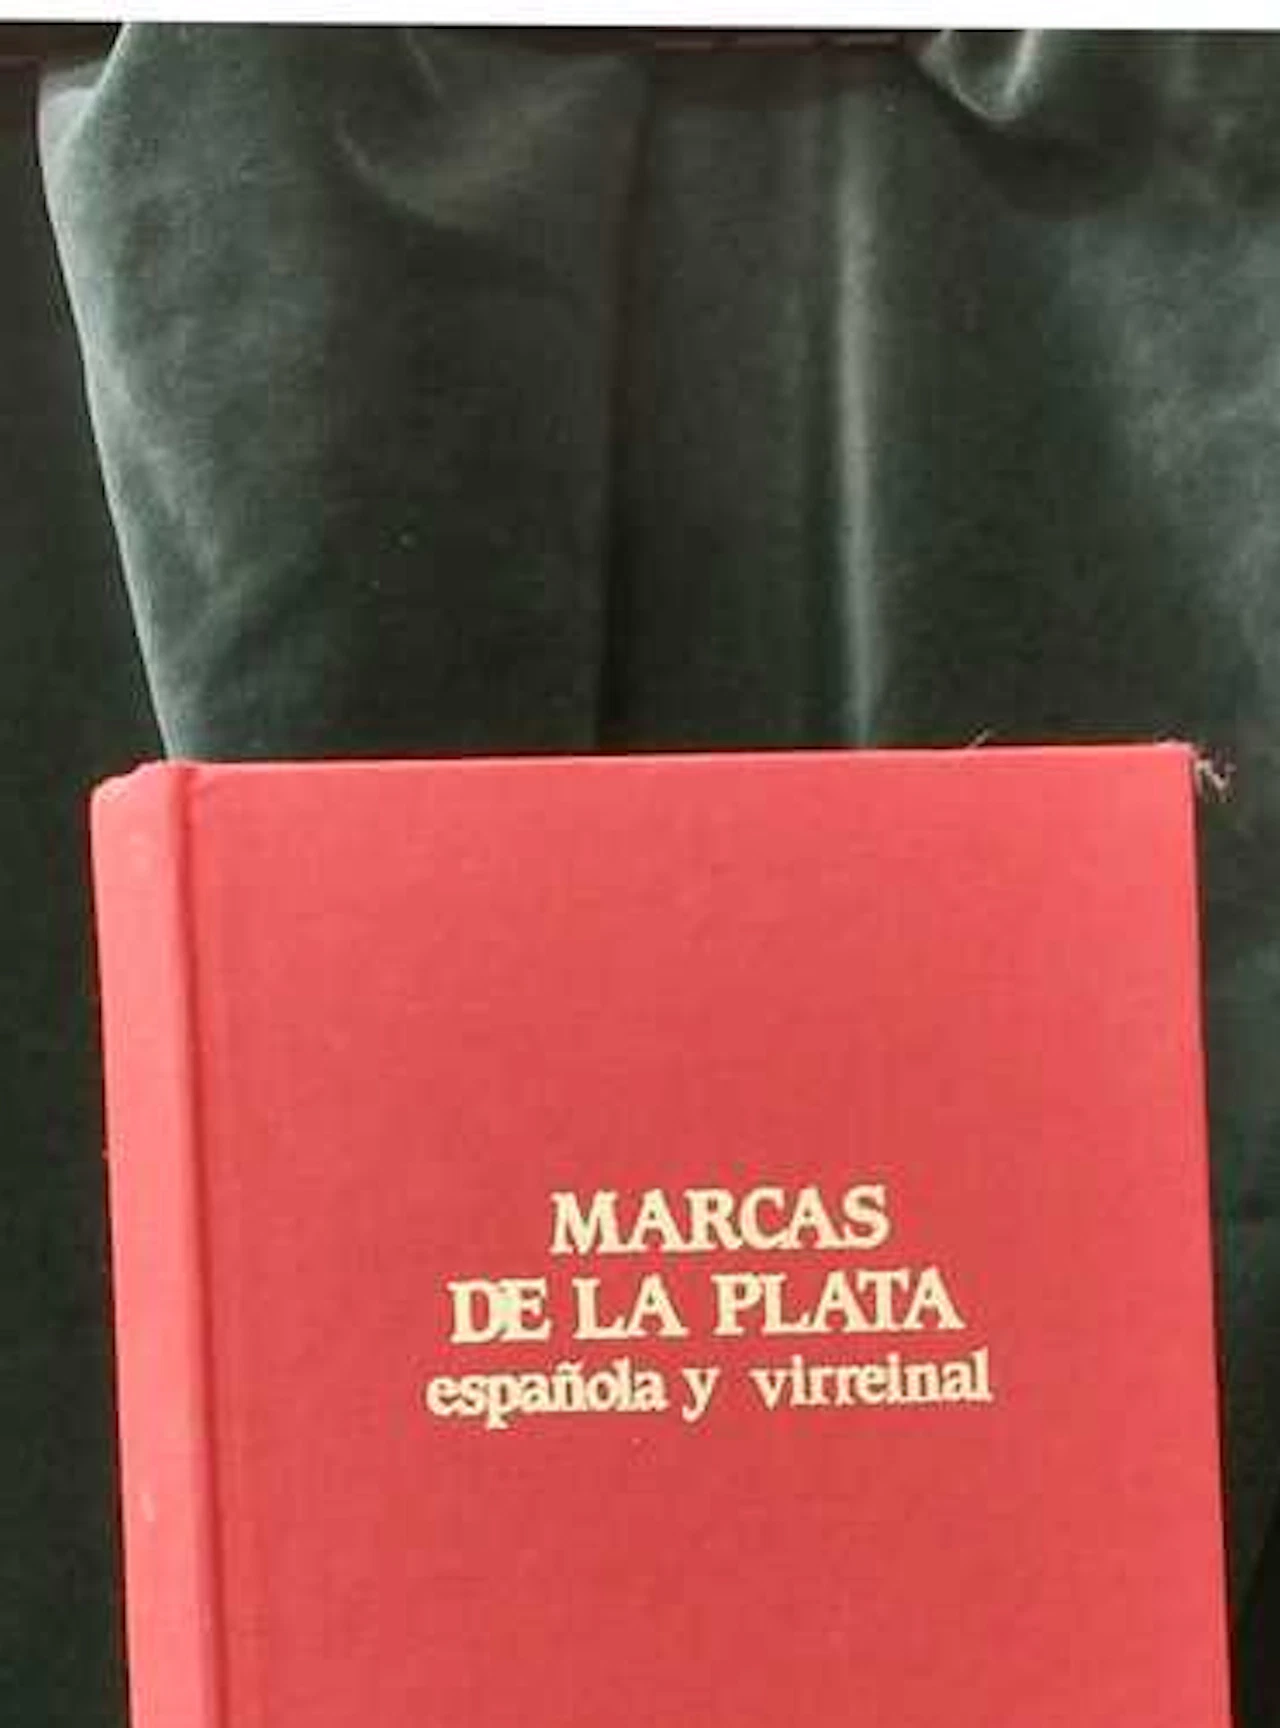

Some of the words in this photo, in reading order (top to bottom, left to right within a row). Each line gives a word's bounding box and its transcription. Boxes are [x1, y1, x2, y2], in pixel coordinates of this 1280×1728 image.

[549, 1184, 890, 1255] MARCAS
[447, 1277, 551, 1344] DE
[572, 1274, 688, 1341] LA
[711, 1266, 966, 1338] PLATA
[425, 1357, 668, 1429] española
[682, 1365, 719, 1422] y
[749, 1348, 994, 1410] virreinal
